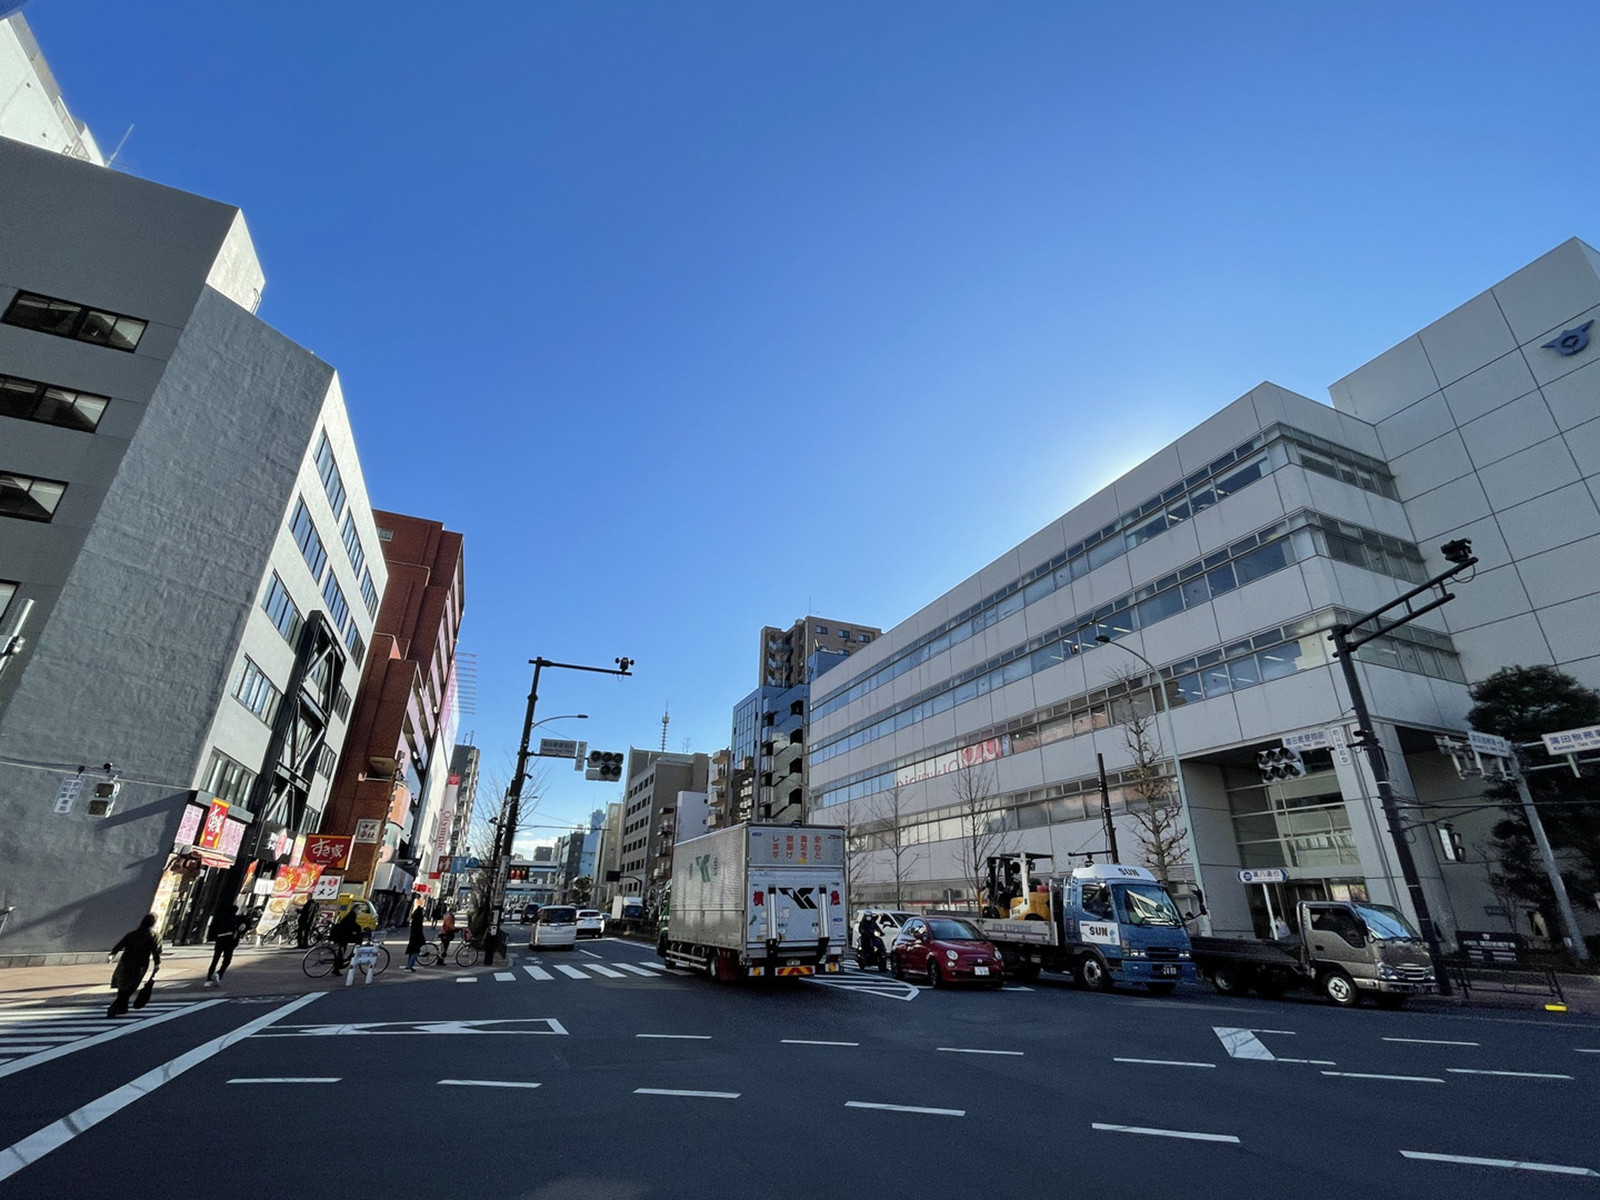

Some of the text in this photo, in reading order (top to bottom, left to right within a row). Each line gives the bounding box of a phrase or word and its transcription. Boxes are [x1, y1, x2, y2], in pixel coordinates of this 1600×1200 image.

[436, 810, 453, 852] Olympic
[311, 838, 345, 860] すき家
[1089, 926, 1108, 937] SUN
